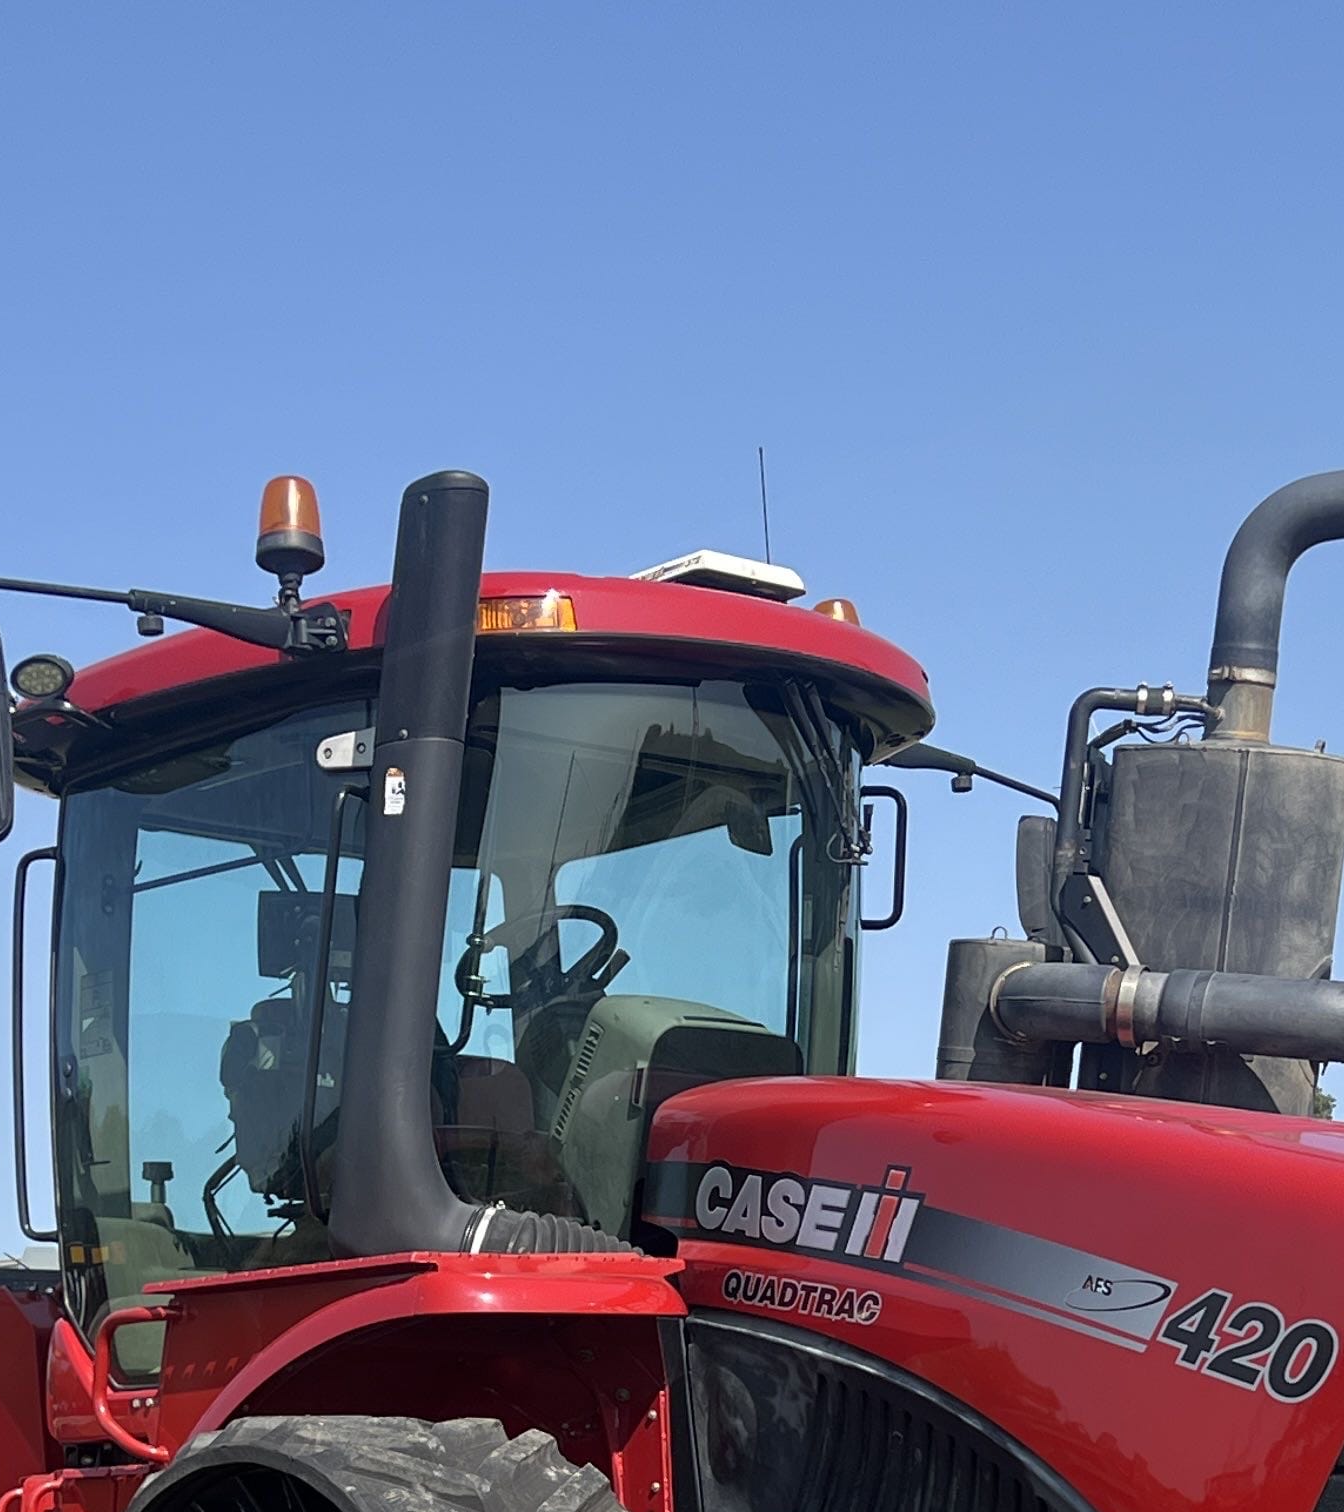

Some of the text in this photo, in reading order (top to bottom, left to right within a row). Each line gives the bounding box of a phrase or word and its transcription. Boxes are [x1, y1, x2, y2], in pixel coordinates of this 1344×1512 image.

[695, 1166, 852, 1251] CASE
[722, 1268, 882, 1325] QUADTRAC
[1081, 1274, 1114, 1297] AFS
[1156, 1287, 1339, 1404] 420
